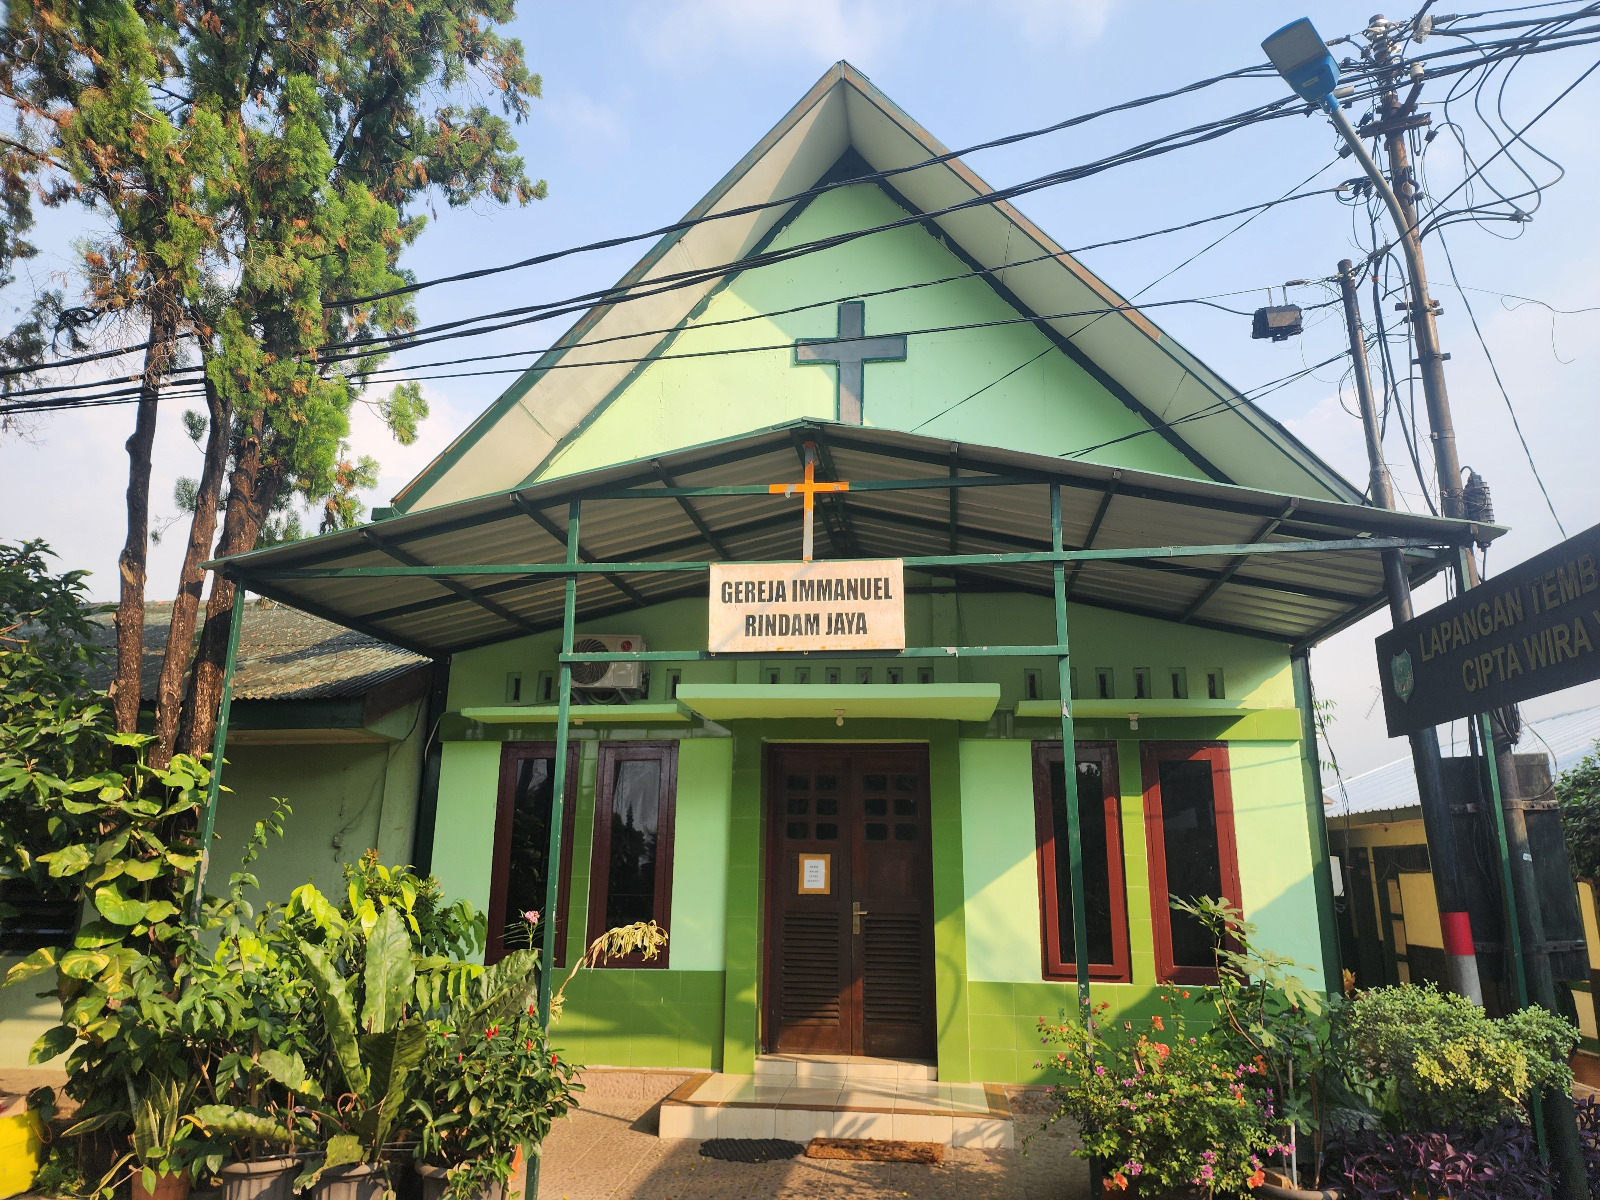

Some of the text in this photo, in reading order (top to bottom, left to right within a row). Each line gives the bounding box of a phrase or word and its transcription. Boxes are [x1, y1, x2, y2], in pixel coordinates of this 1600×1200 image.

[721, 577, 893, 604] GEREJA IMMANUEL
[744, 612, 868, 637] RINDAM JAYA
[1418, 587, 1524, 662] LAPANGAN
[1462, 616, 1594, 692] CIPTA WIRA
